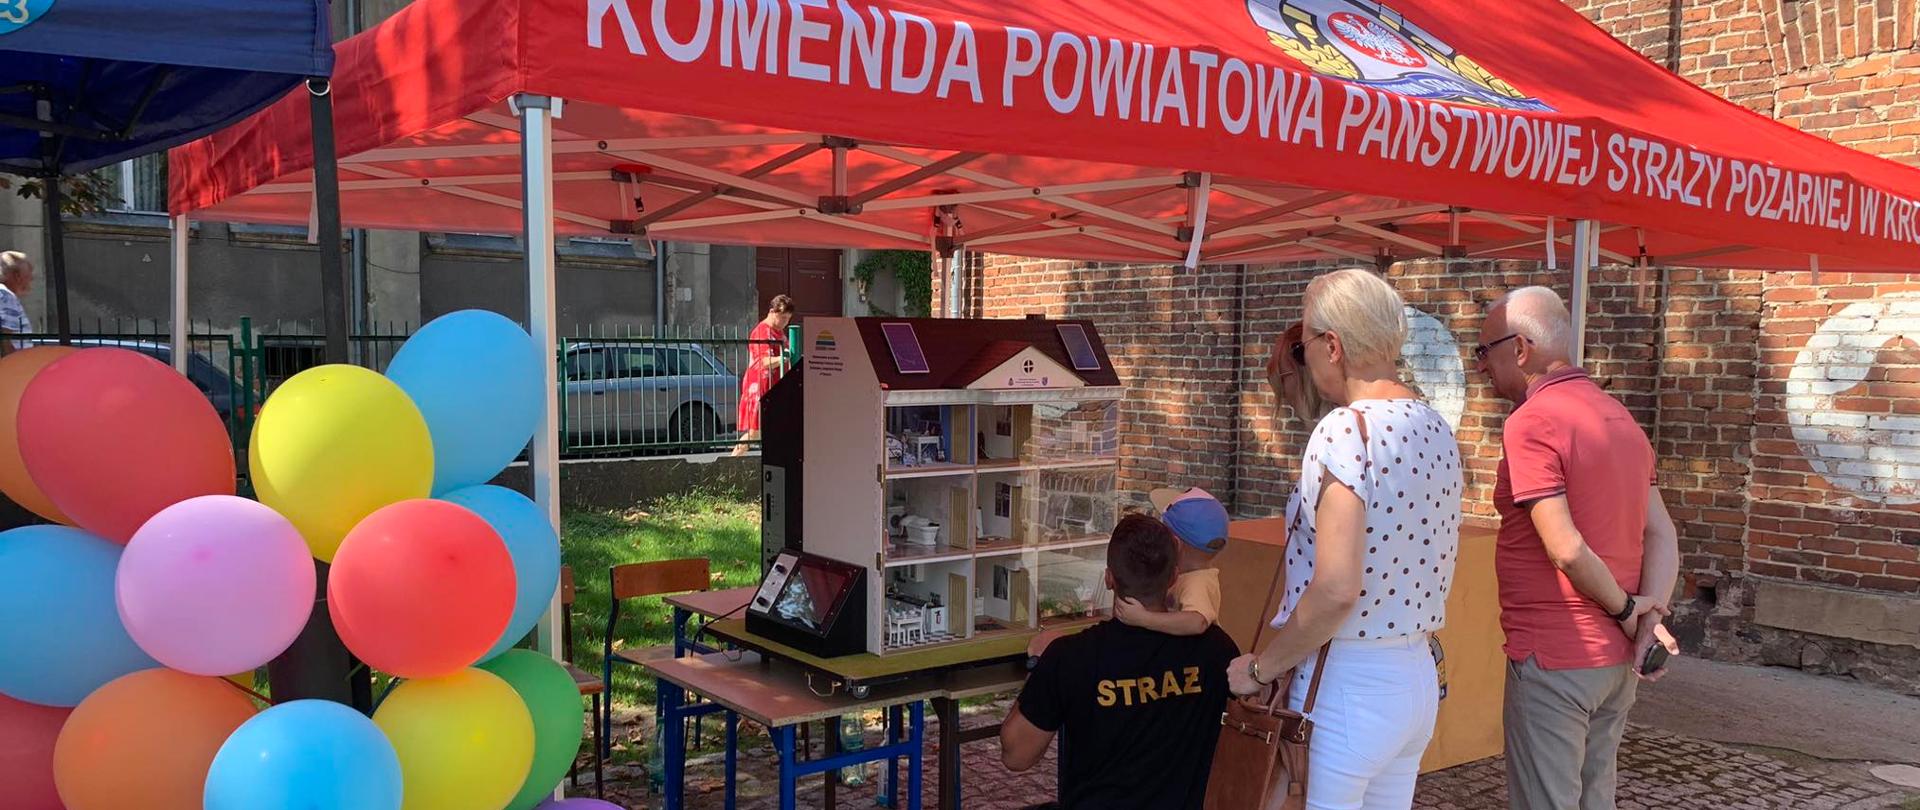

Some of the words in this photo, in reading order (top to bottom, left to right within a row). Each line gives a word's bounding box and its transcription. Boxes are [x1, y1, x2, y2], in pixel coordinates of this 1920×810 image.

[587, 0, 984, 103] KOMENDA
[1002, 26, 1323, 148] POWIATOWA
[1860, 186, 1880, 237] W
